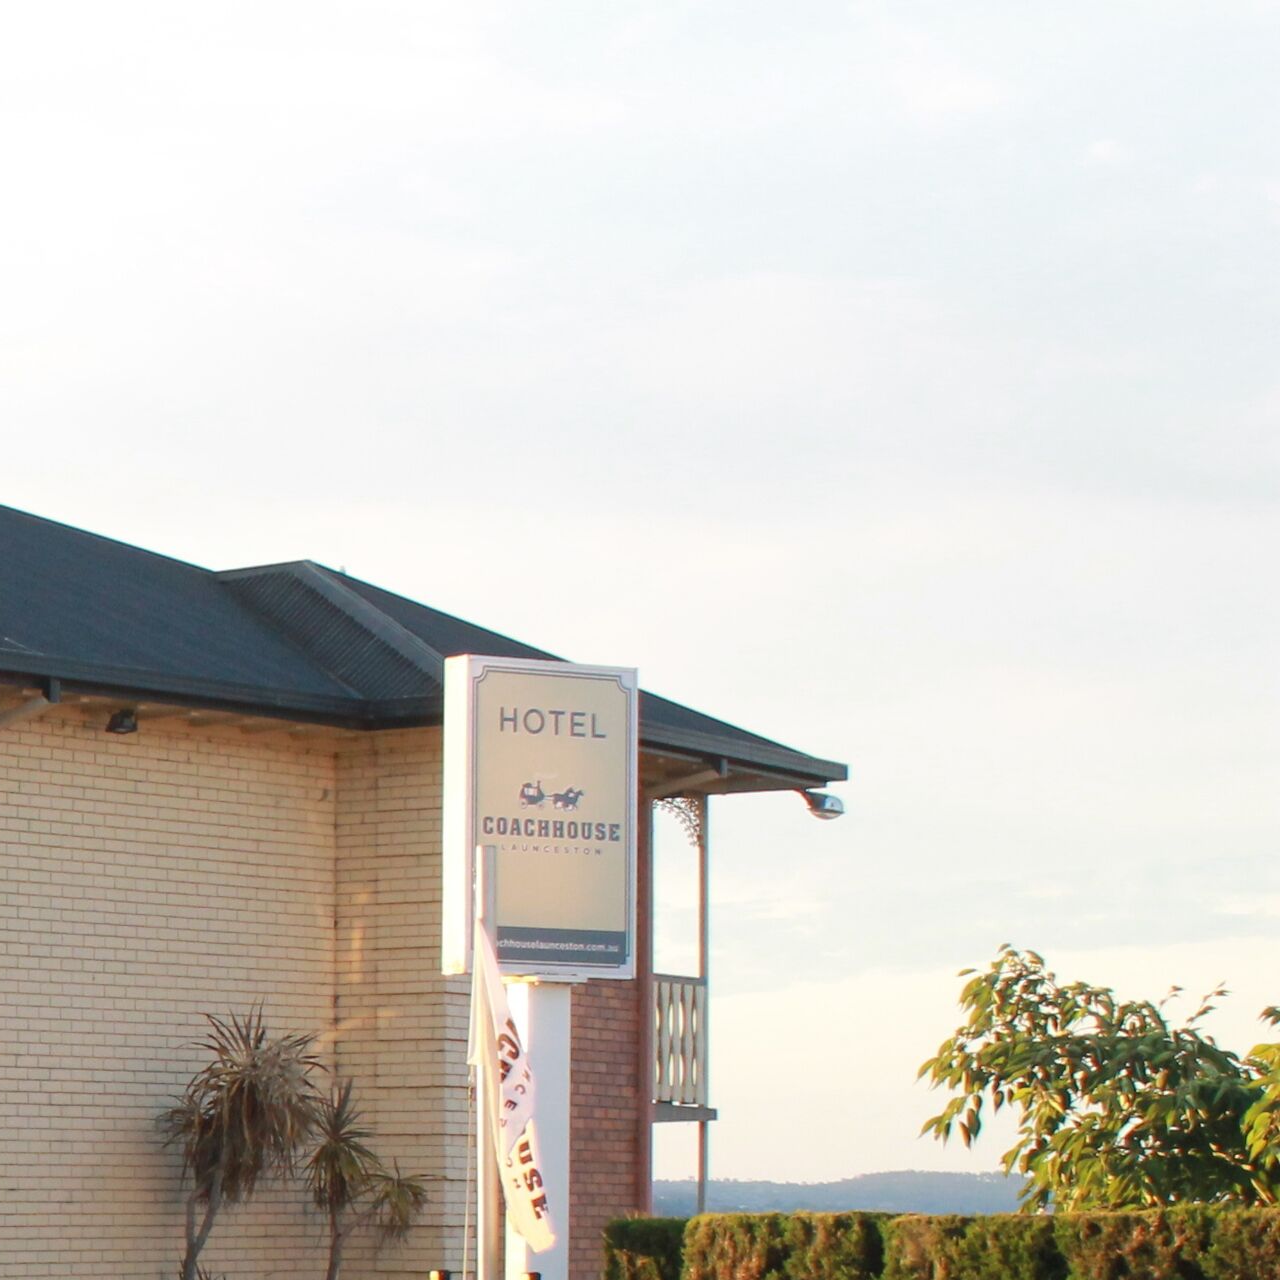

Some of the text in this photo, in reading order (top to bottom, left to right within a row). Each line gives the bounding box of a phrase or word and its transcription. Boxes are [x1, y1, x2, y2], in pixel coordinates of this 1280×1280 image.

[500, 707, 607, 739] HOTEL
[482, 816, 621, 842] COACHHOUSE
[501, 844, 602, 855] LAUNCESTON
